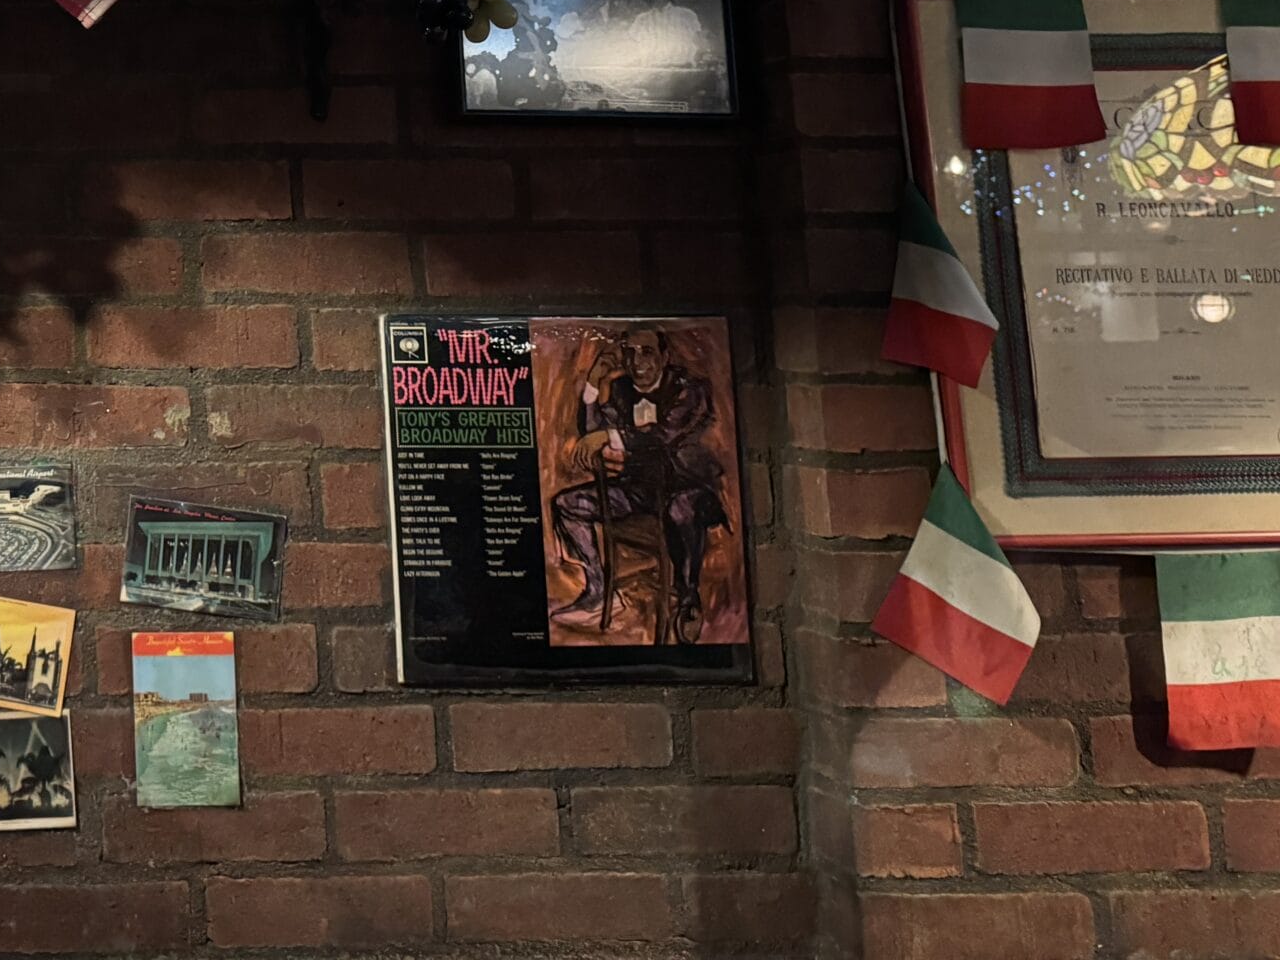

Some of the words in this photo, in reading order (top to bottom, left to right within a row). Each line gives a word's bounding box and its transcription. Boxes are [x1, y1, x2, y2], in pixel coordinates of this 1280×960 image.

[1056, 268, 1133, 285] RECITATIVO
[1141, 268, 1149, 284] E
[1157, 268, 1216, 284] BALLATA
[1224, 268, 1237, 284] DI
[393, 366, 529, 405] BROADWAY"
[399, 411, 449, 426] TONY'S
[458, 411, 528, 426] GREATEST
[401, 428, 487, 443] BROADWAY
[497, 429, 530, 443] HITS
